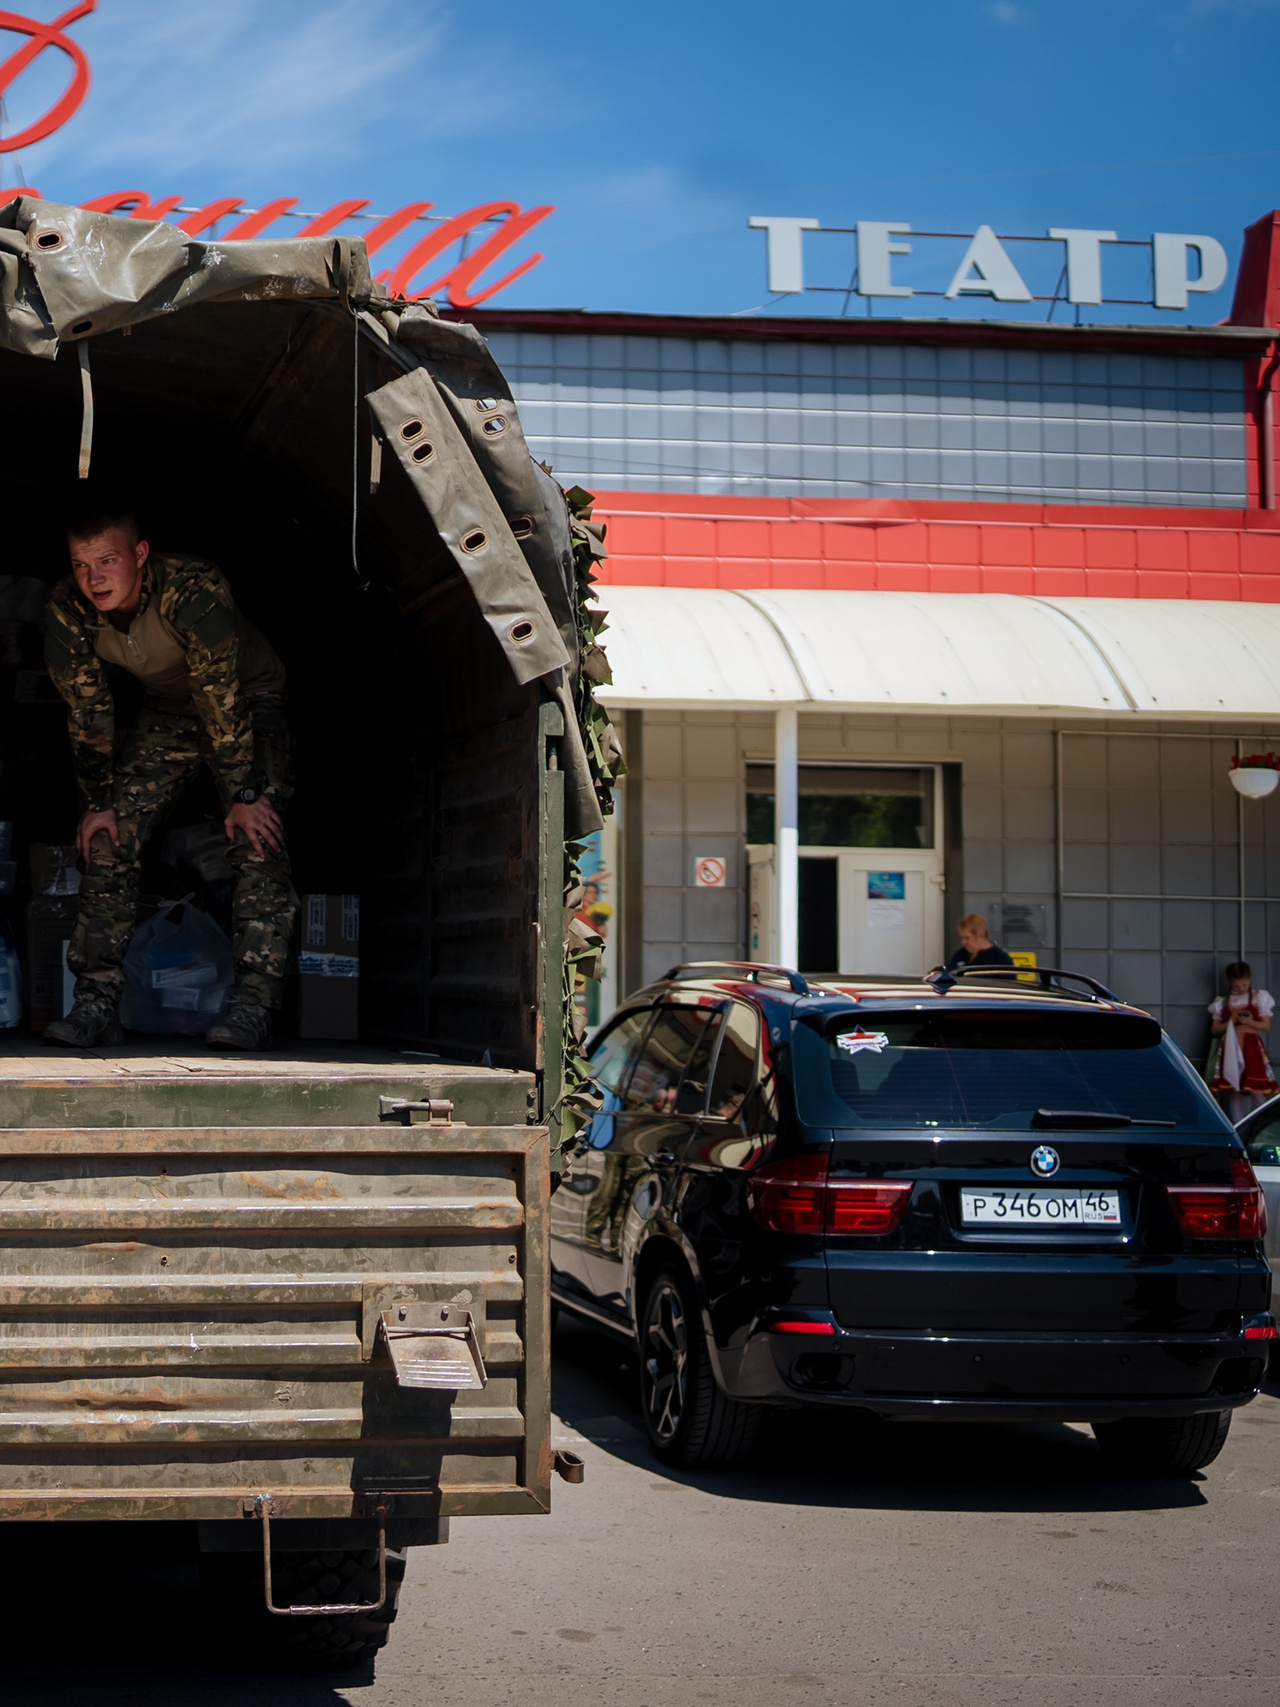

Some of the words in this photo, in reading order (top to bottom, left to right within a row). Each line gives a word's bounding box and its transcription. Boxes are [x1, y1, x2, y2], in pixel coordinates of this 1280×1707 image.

[748, 215, 1229, 310] ТЕАТР
[1085, 1192, 1110, 1212] 46
[1084, 1212, 1103, 1220] RUS
